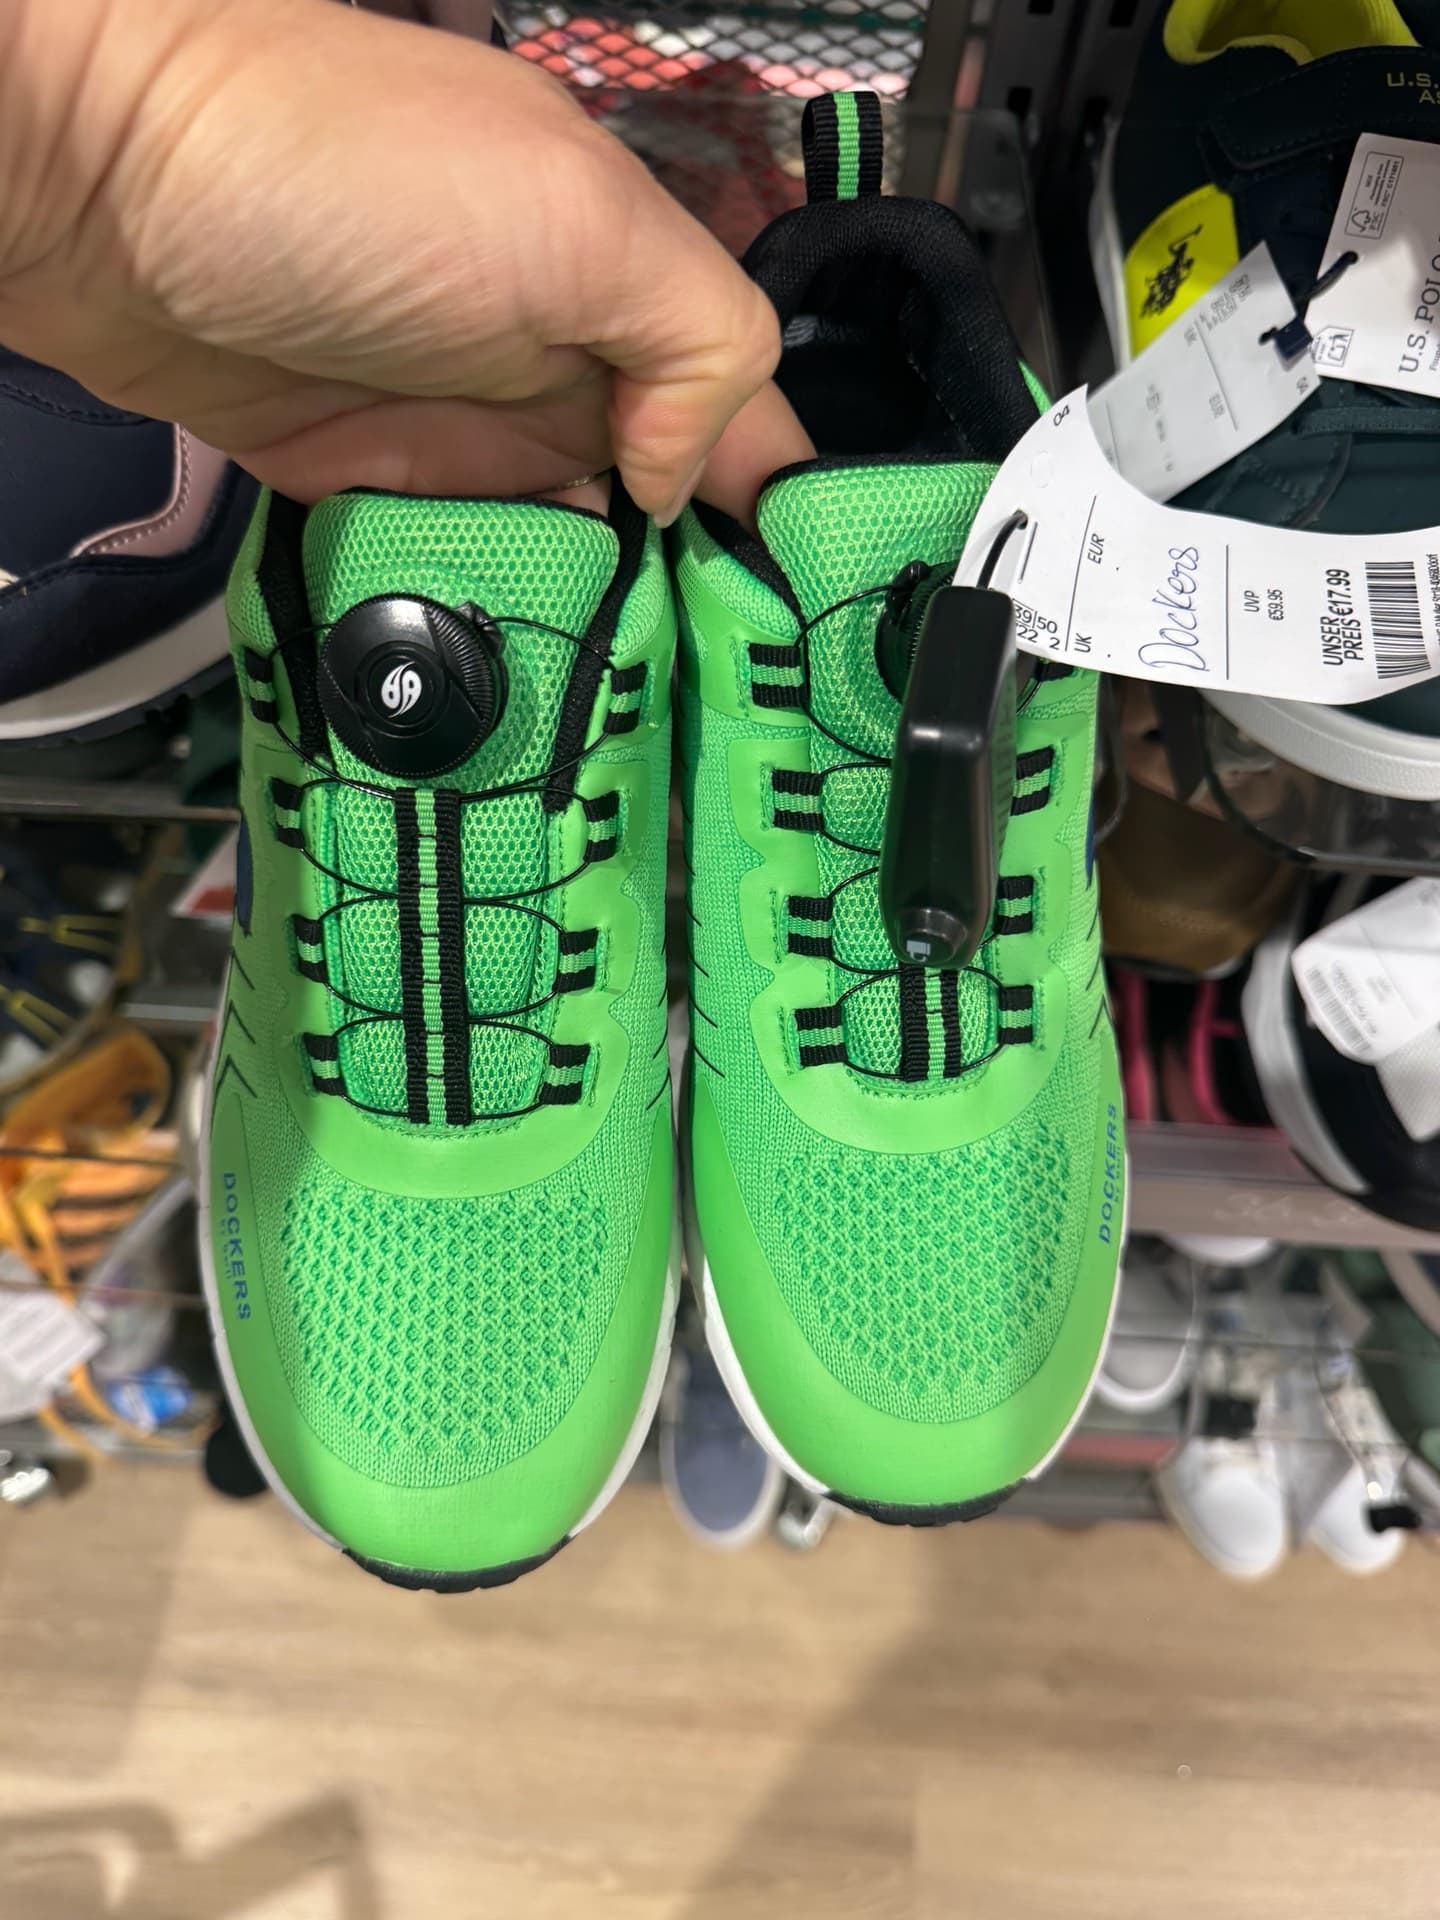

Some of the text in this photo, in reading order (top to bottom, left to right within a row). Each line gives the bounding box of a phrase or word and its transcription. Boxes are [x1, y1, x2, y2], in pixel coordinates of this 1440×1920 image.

[1386, 71, 1440, 89] U.S.
[1398, 330, 1431, 373] U.S.
[1053, 405, 1070, 426] 04
[1087, 533, 1104, 564] EUR
[1243, 590, 1260, 613] UVP
[1267, 588, 1284, 621] €59.95
[1325, 568, 1354, 617] €17.99
[1015, 622, 1061, 650] 22 2
[1036, 616, 1058, 634] 50
[1320, 616, 1344, 666] UNSER
[1341, 617, 1364, 660] PREIS
[1073, 632, 1092, 653] UK
[1099, 1103, 1117, 1245] DOCKERS
[223, 1172, 251, 1320] DOCKERS
